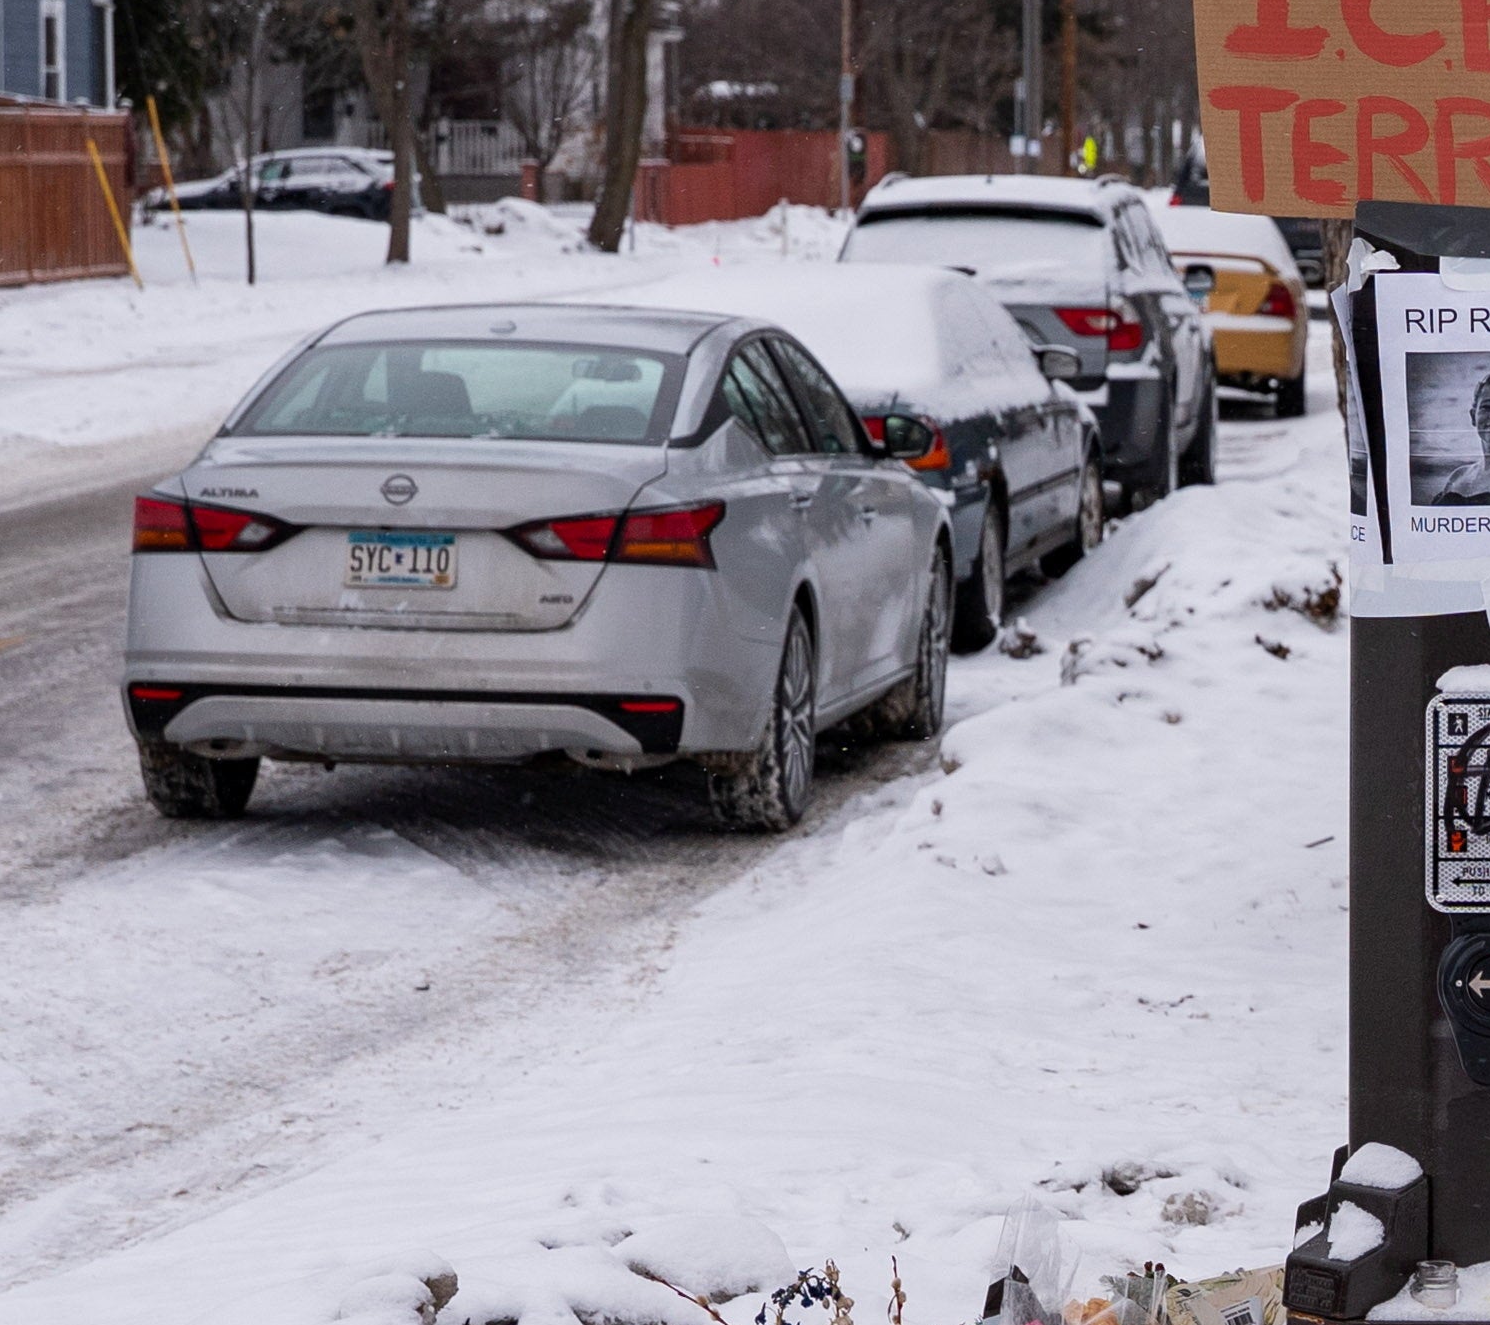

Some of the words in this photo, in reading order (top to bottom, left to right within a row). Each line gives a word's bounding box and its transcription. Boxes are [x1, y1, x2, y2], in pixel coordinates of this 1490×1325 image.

[1405, 309, 1458, 333] RIP
[1350, 526, 1366, 542] CE
[350, 544, 392, 573] SYC
[409, 545, 450, 573] 110
[1461, 867, 1489, 876] PUSH
[1472, 886, 1485, 895] TO
